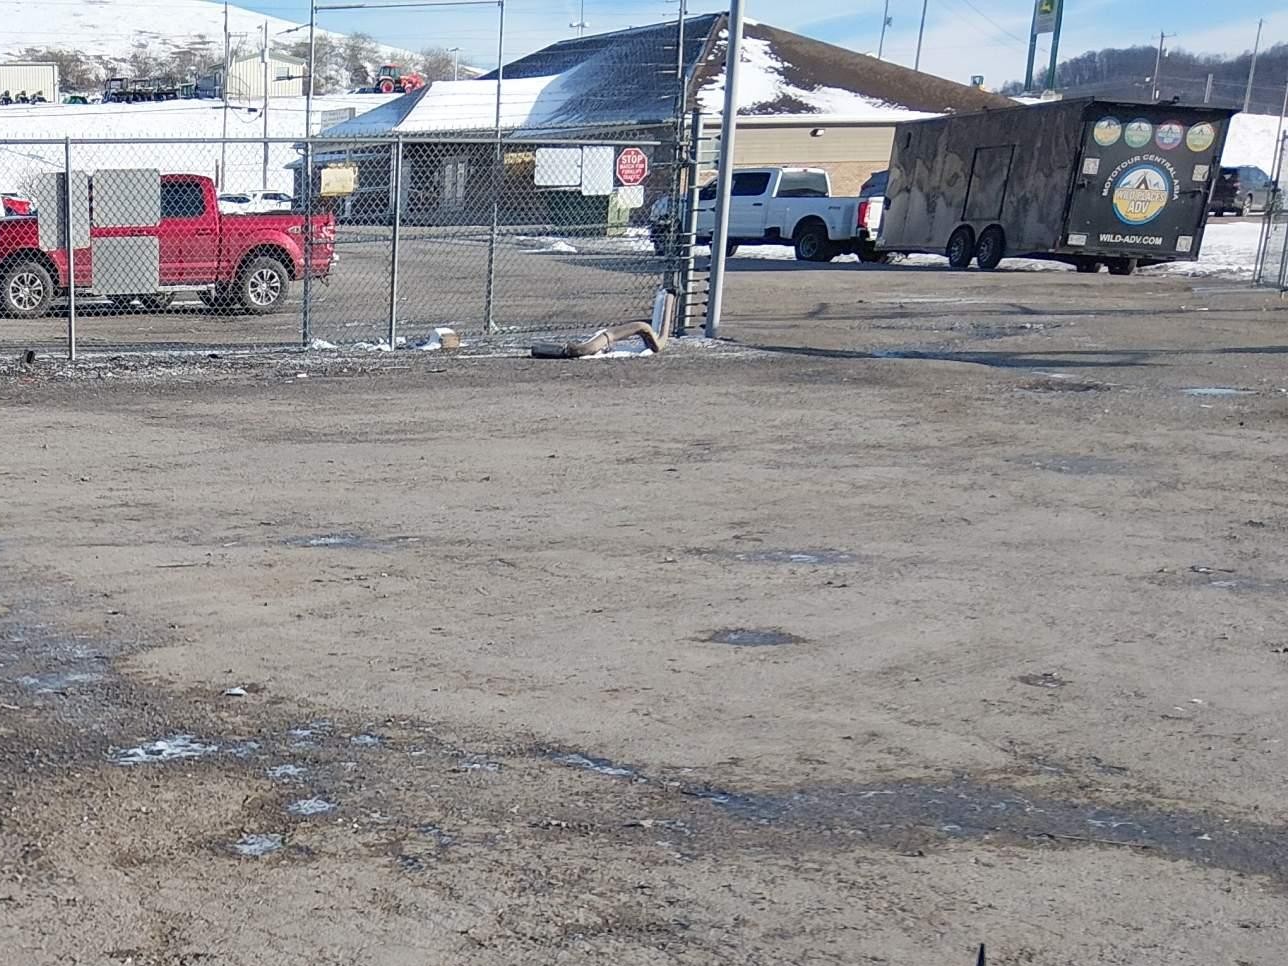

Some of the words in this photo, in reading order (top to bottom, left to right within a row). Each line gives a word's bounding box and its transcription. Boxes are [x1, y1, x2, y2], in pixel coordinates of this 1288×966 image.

[622, 155, 643, 164] STOP
[1102, 156, 1140, 196] MOTOTOUR
[1142, 154, 1177, 178] CENTRAL
[1116, 190, 1137, 200] WILD
[1137, 191, 1165, 202] PLACES
[1128, 201, 1149, 213] ADV
[1099, 233, 1163, 246] WILD-ADV.COM
